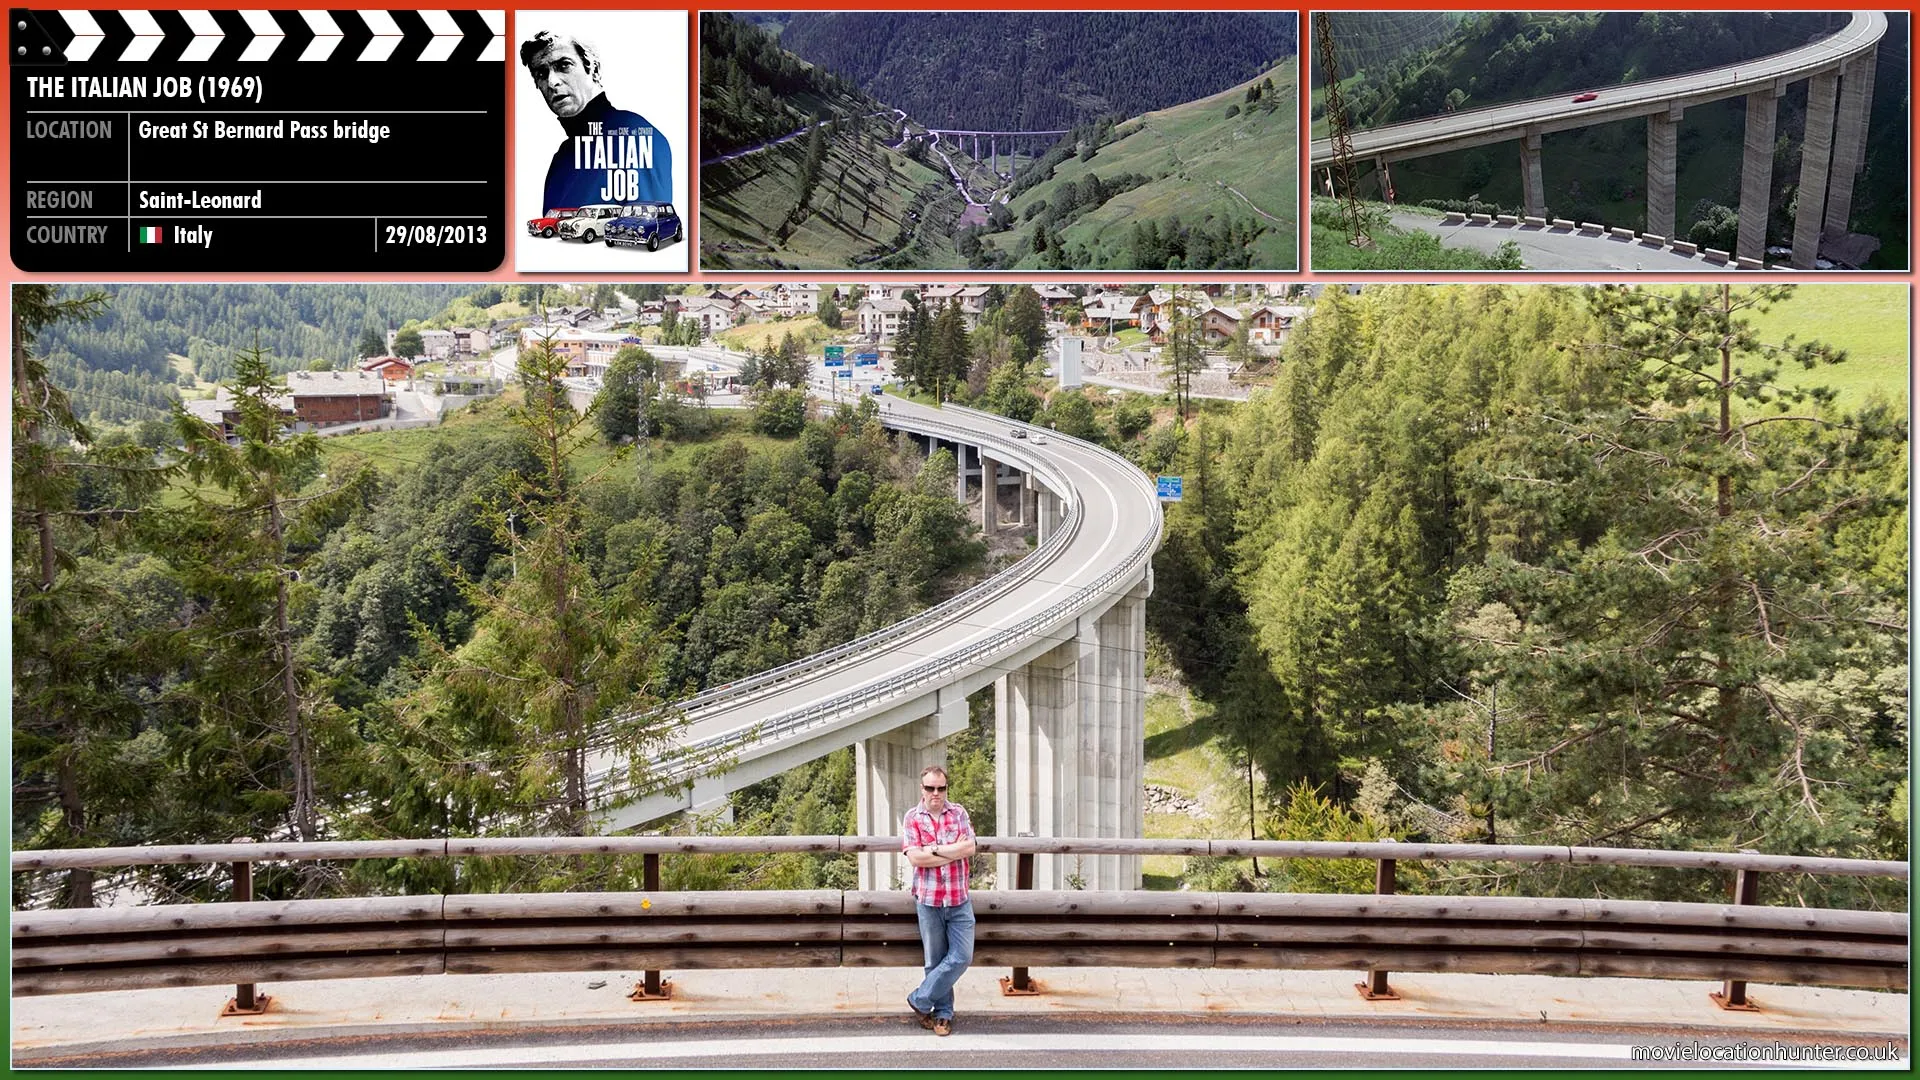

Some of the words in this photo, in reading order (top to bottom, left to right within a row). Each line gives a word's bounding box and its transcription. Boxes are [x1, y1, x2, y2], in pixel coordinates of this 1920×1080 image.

[588, 122, 603, 135] THE
[574, 136, 653, 169] ITALIAN
[601, 169, 639, 201] JOB
